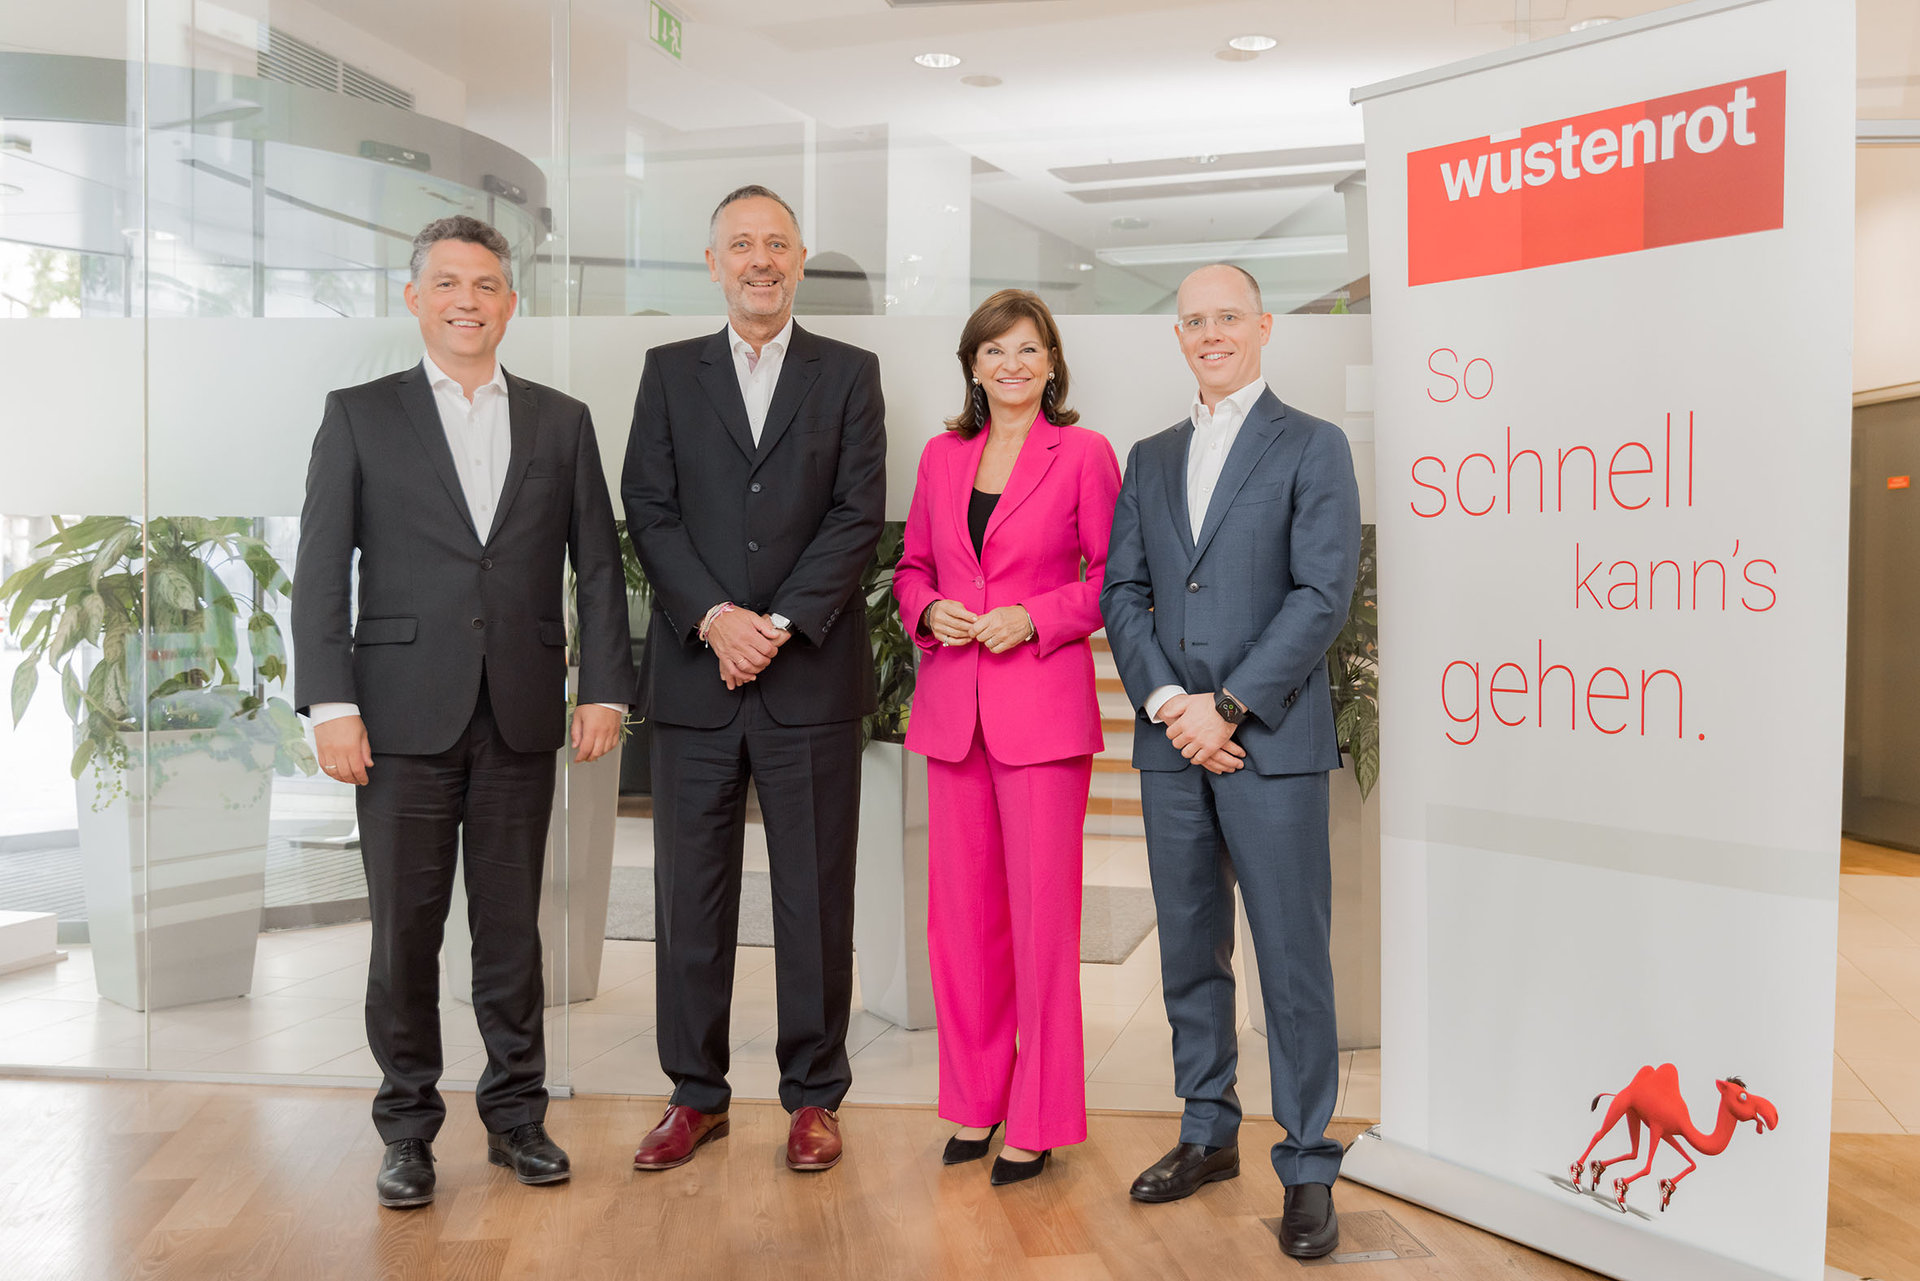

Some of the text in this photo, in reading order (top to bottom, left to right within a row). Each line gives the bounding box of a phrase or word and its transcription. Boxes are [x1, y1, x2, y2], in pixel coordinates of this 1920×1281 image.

[1427, 348, 1494, 403] So
[1410, 411, 1693, 518] schnell
[1576, 539, 1777, 612] kann's
[1441, 639, 1705, 745] gehen.
